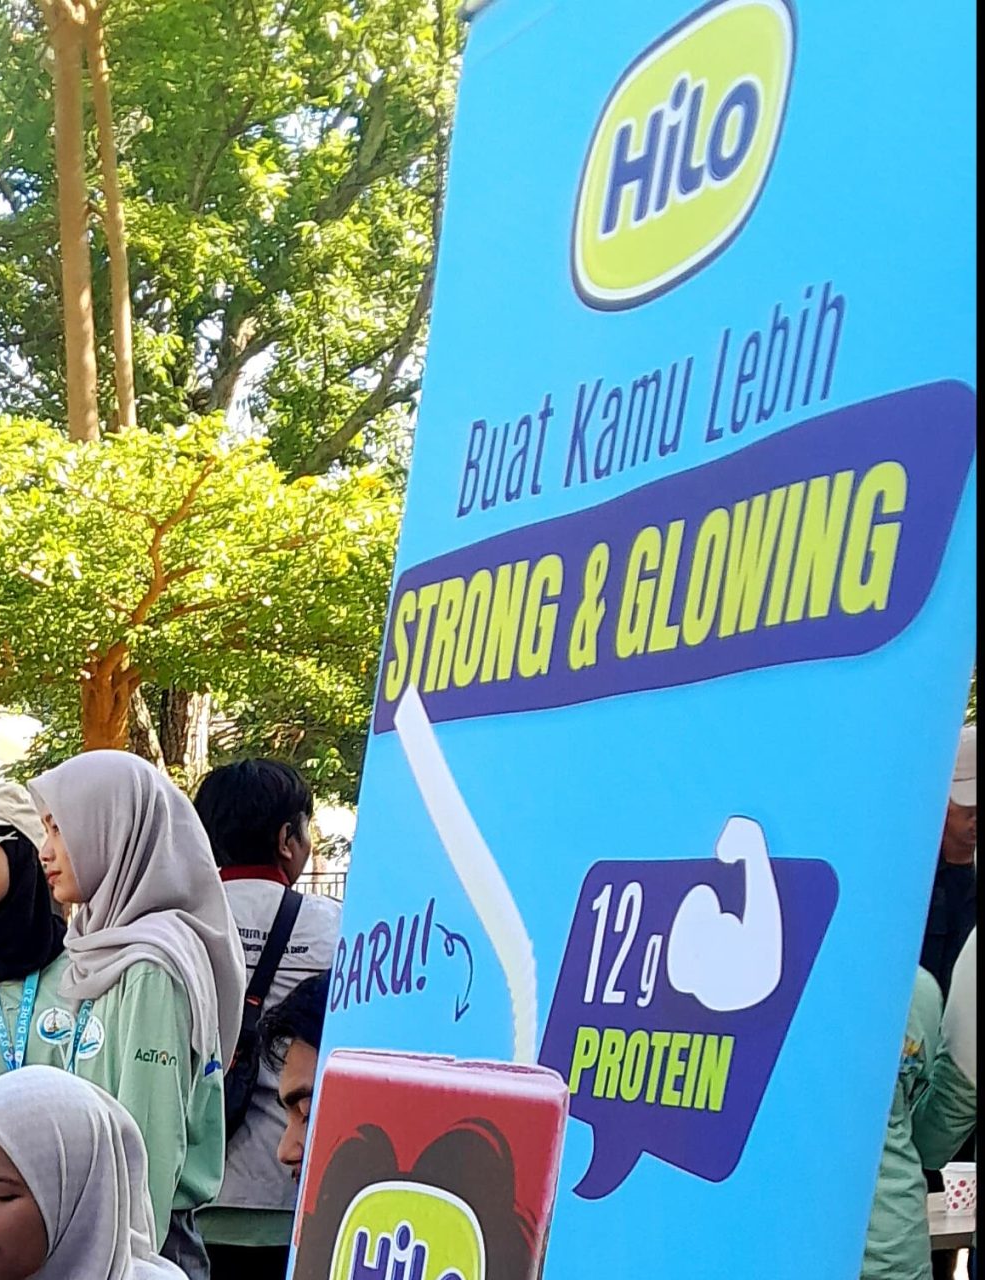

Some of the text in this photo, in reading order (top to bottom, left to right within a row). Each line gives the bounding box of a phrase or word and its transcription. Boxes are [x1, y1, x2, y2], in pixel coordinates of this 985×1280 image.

[600, 73, 760, 235] HiLo
[456, 280, 847, 518] Buat Kamu Lebih
[384, 460, 909, 702] STRONG & GLOWING
[17, 1005, 31, 1034] DARE
[329, 897, 434, 1013] BARU!
[569, 1026, 734, 1112] PROTEIN
